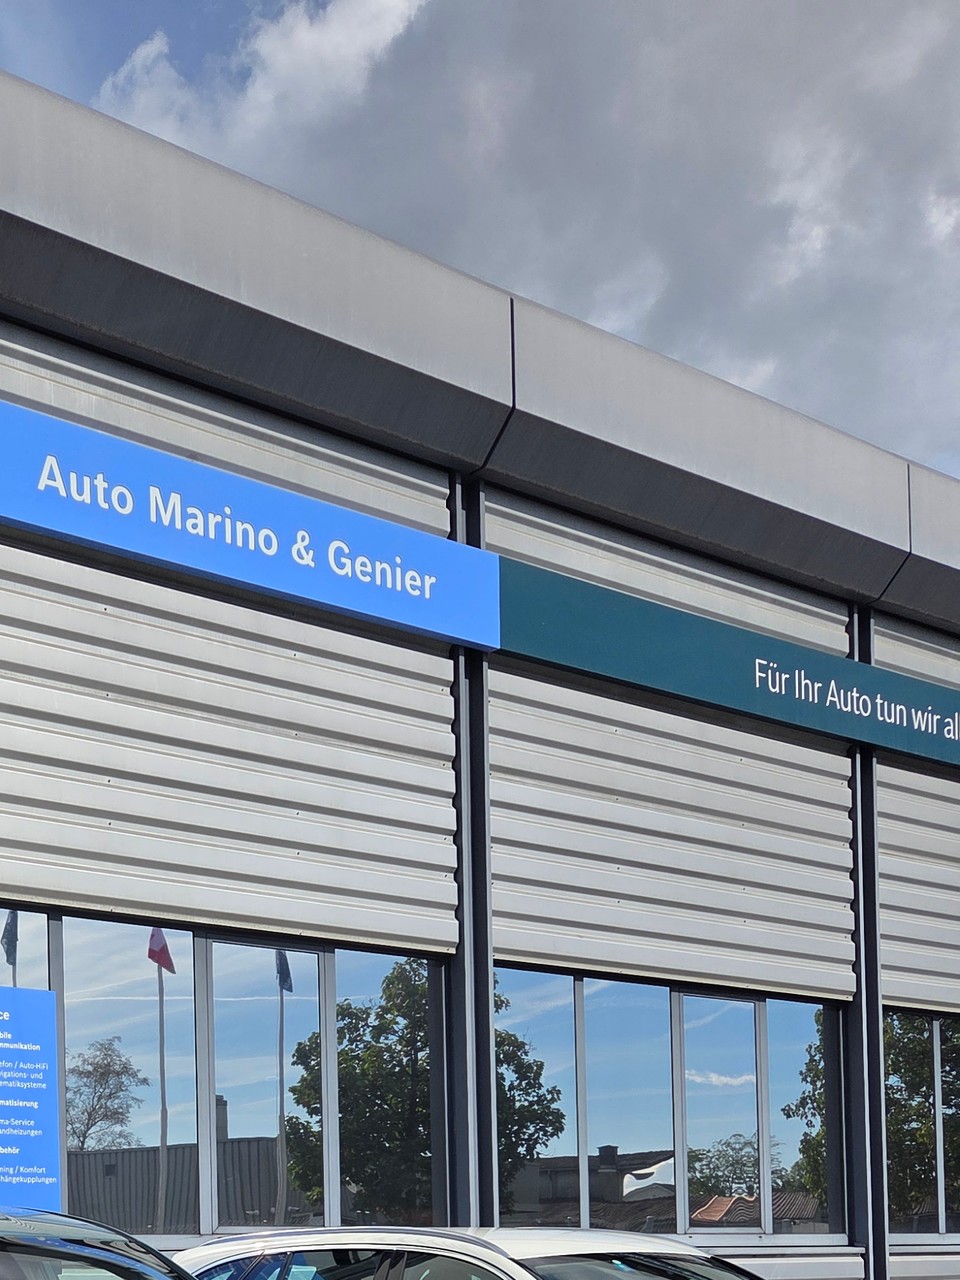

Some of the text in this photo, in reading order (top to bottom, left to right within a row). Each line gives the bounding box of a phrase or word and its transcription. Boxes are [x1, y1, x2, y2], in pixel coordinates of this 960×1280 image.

[37, 454, 437, 600] Auto Marino & Genier
[754, 658, 790, 695] Für
[794, 669, 822, 704] Ihr
[825, 679, 872, 717] Auto
[875, 693, 907, 727] tun
[911, 705, 941, 735] wir
[30, 1071, 43, 1080] und
[19, 1166, 46, 1174] Komfort
